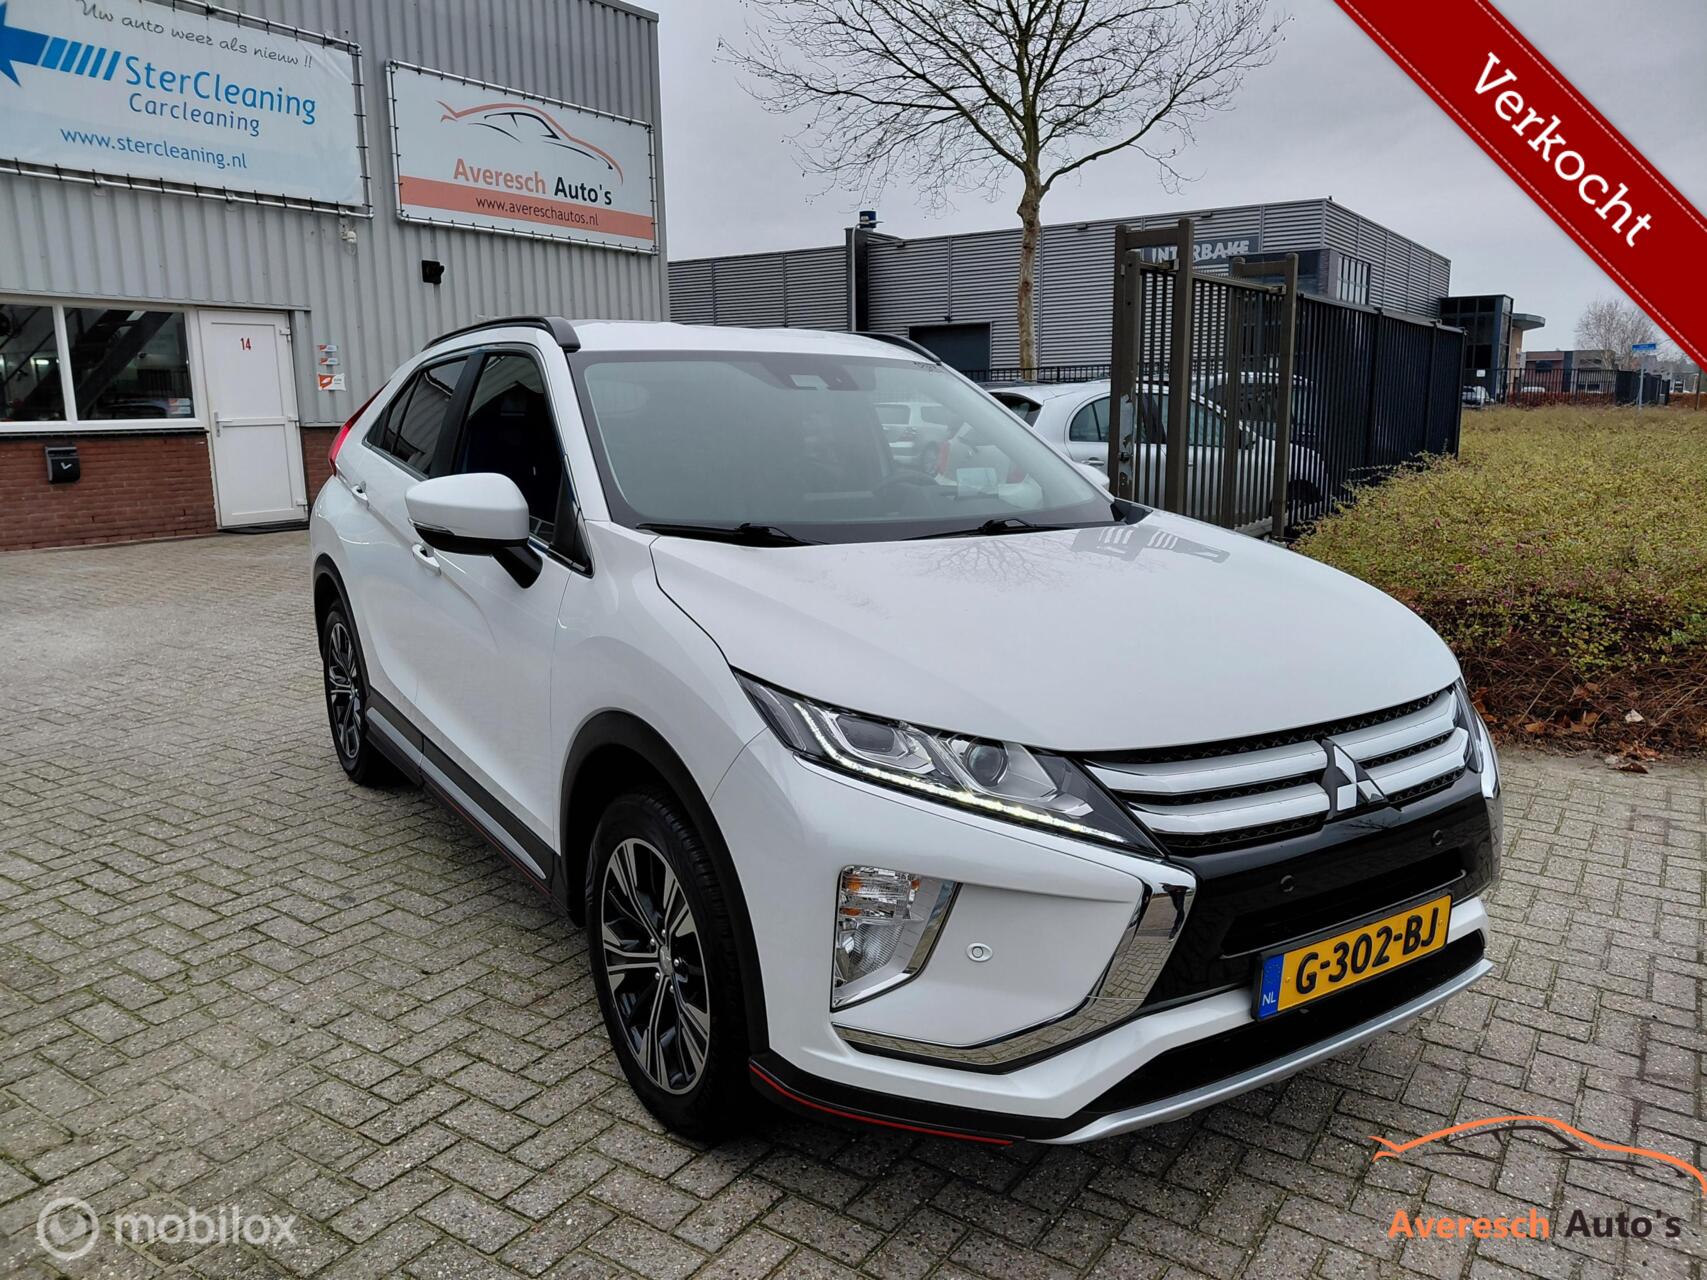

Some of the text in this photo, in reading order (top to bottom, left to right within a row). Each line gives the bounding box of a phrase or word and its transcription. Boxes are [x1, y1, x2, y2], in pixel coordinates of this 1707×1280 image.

[74, 0, 314, 68] Uw auto weer als nieuw !!
[125, 56, 316, 125] SterCleaning
[129, 93, 261, 137] Carcleaning
[60, 128, 248, 169] www.stercleaning.nl
[453, 158, 612, 205] Averesch Auto's
[475, 197, 599, 226] www.avereschautos.nl
[1151, 240, 1250, 264] INTRBAKE
[240, 337, 252, 351] 14
[1295, 907, 1439, 995] G-302-BJ
[1262, 992, 1276, 1006] NL
